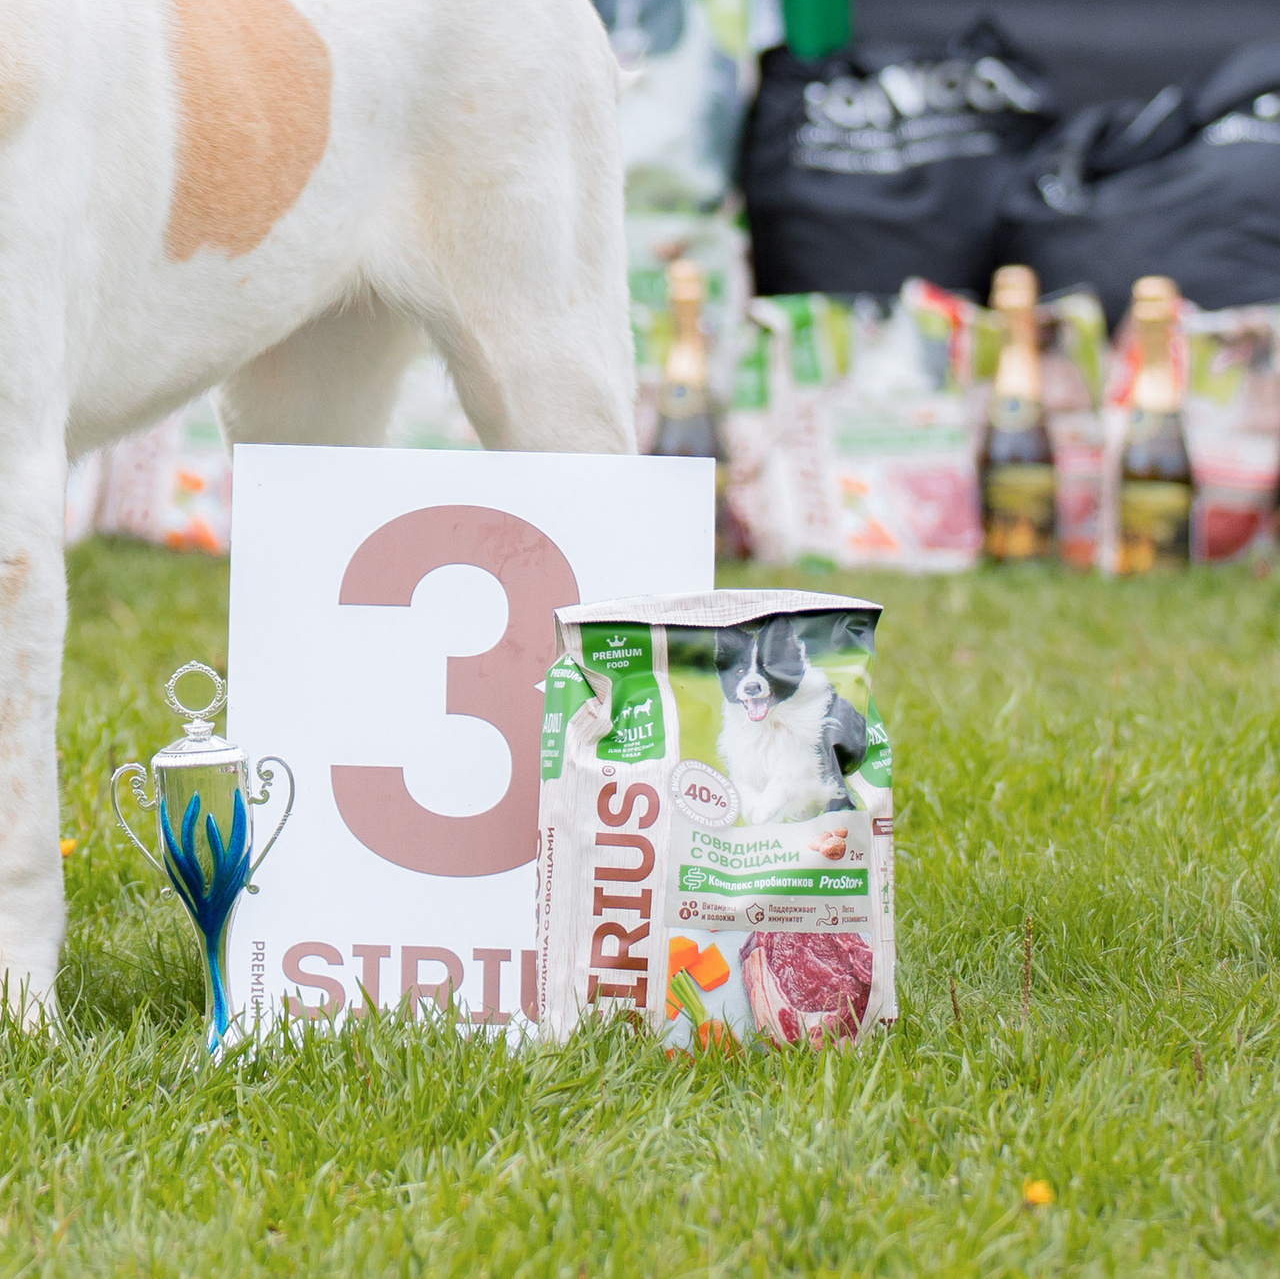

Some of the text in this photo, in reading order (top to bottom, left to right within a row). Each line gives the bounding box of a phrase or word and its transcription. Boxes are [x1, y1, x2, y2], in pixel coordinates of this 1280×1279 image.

[592, 647, 643, 661] PREMIUM
[606, 660, 630, 670] FOOD
[331, 504, 580, 878] 3
[683, 783, 727, 808] 40%
[692, 830, 783, 856] ГОВЯДИНА
[690, 847, 801, 870] С ОВОЩАМИ
[708, 874, 864, 891] Комплекс пробиотиков ProStor+
[768, 904, 817, 915] Поддерживает
[250, 941, 265, 1020] PREMIUM
[281, 940, 539, 1026] SIRI
